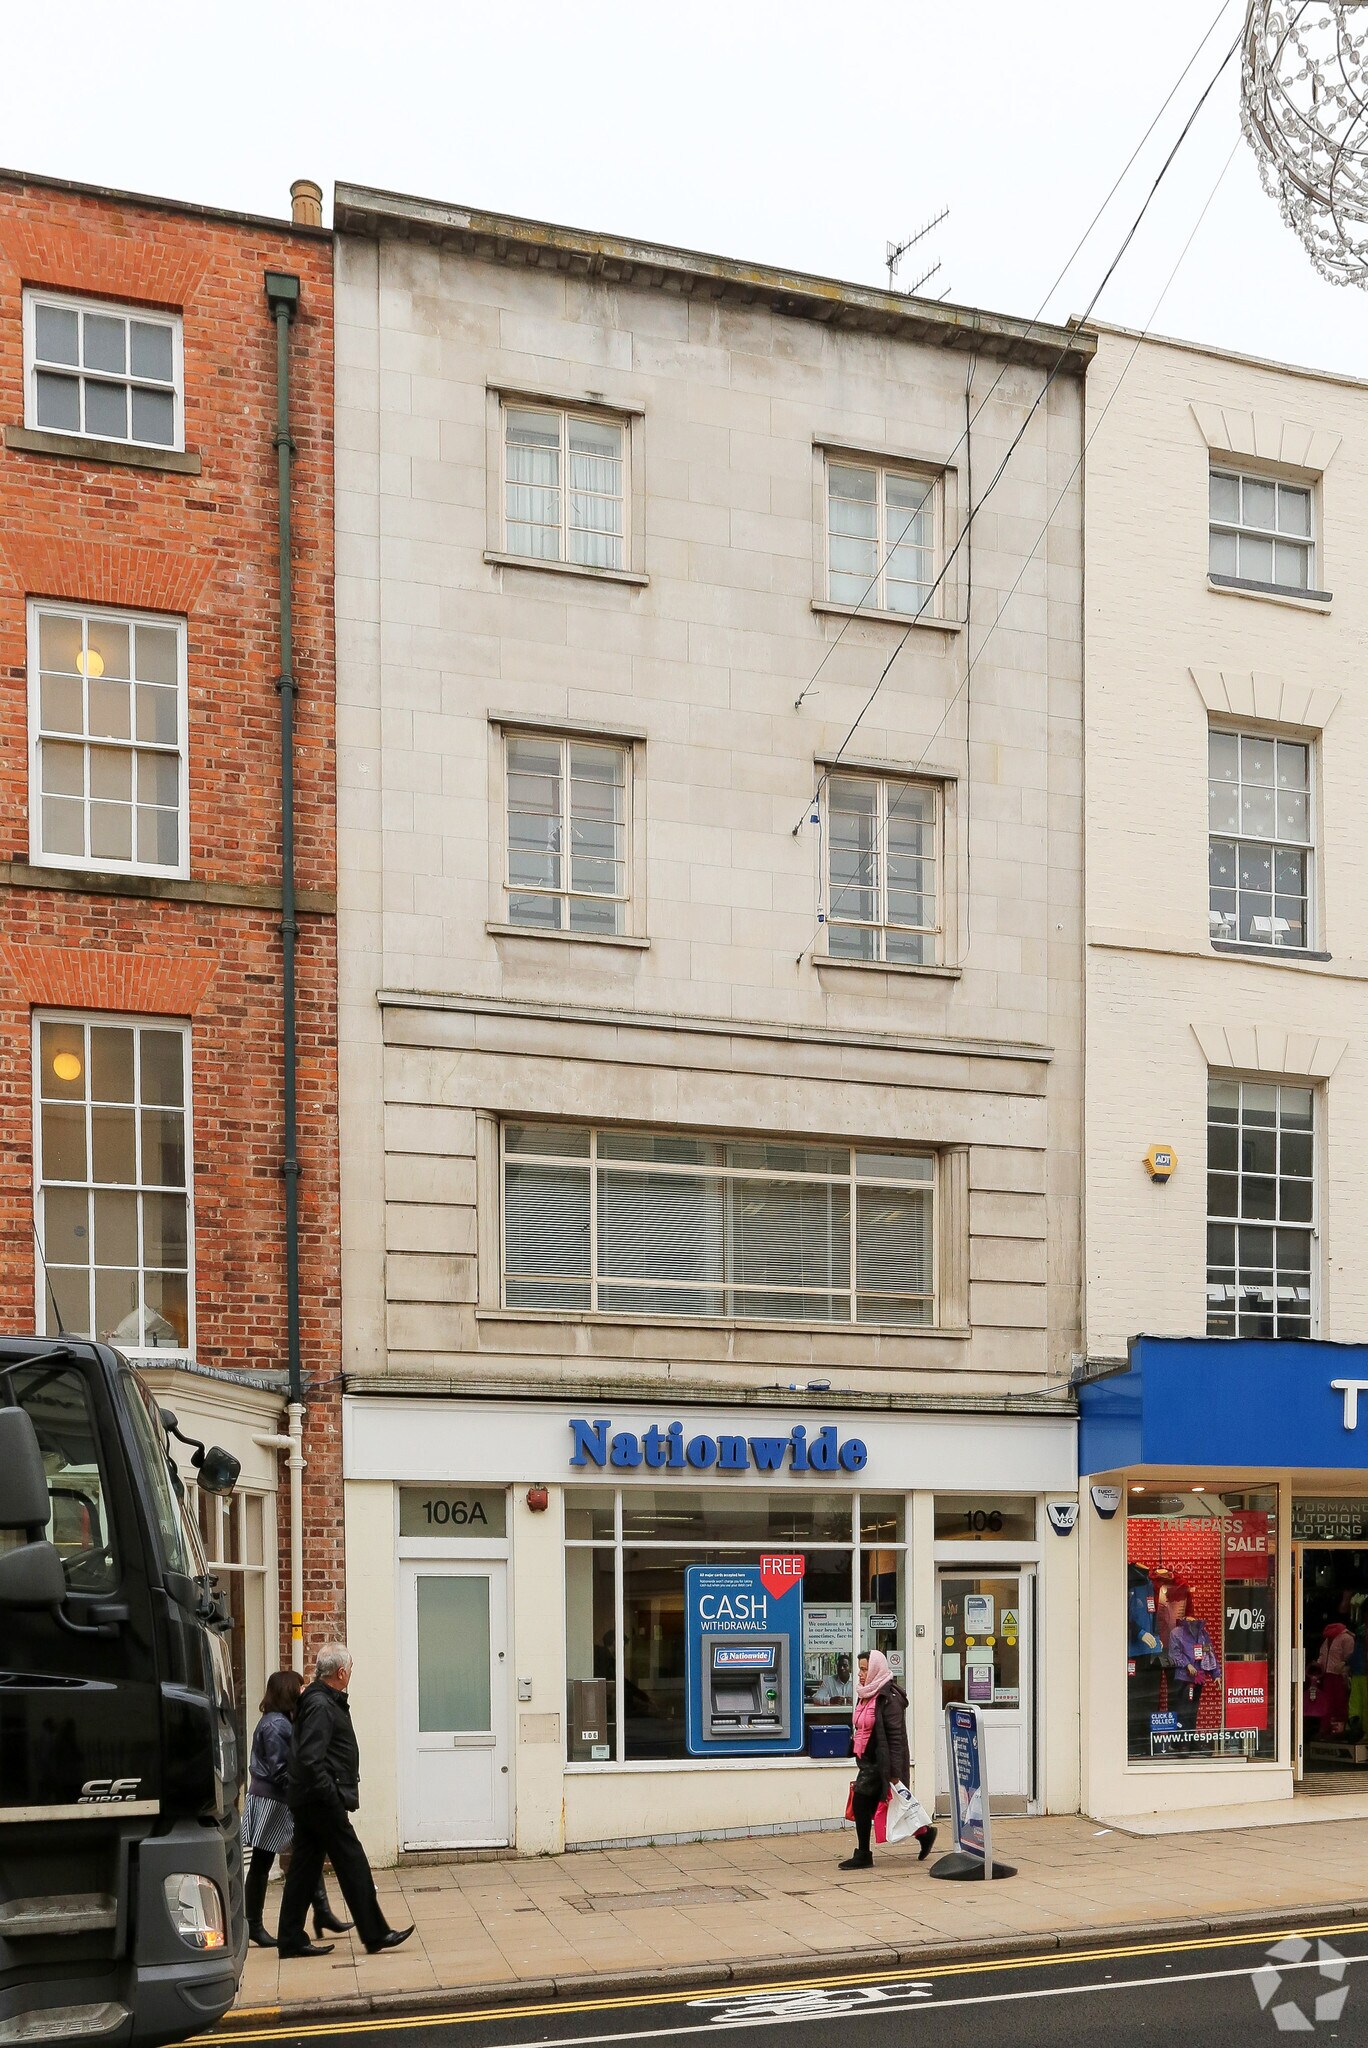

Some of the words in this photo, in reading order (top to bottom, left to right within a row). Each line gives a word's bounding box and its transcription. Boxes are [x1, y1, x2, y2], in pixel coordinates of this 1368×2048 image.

[1156, 1155, 1170, 1164] ADT
[569, 1419, 868, 1472] Nationwide
[422, 1500, 488, 1525] 106A
[963, 1510, 1003, 1532] 106
[1159, 1518, 1243, 1533] TRESPASS
[1294, 1524, 1362, 1535] LOTHING
[1227, 1536, 1266, 1552] SALE
[763, 1558, 802, 1575] FREE
[699, 1594, 767, 1620] CASH
[700, 1620, 767, 1631] WITHDRAWALS
[1227, 1608, 1265, 1630] 70%
[1252, 1622, 1265, 1630] OFF
[729, 1652, 768, 1660] Nationwide
[1227, 1687, 1264, 1696] FURTHER
[1227, 1696, 1264, 1704] REDUCTIONS
[1153, 1729, 1256, 1743] www.trespass.com
[82, 1778, 142, 1796] CF
[77, 1795, 123, 1804] EURO
[125, 1794, 136, 1802] 6
